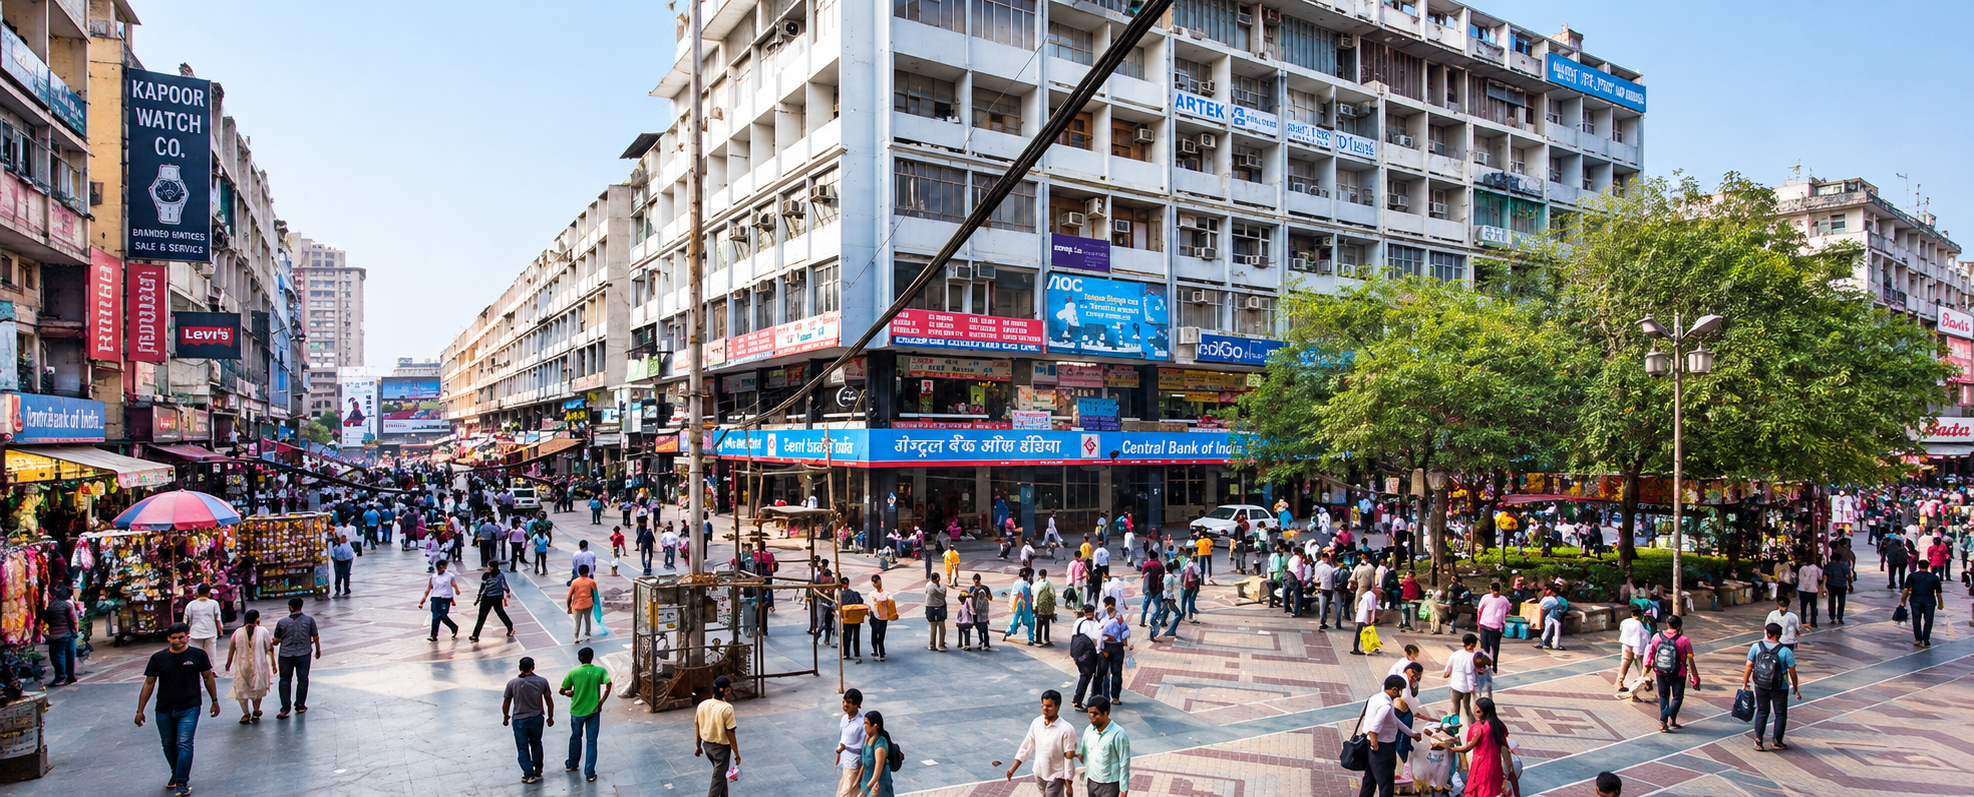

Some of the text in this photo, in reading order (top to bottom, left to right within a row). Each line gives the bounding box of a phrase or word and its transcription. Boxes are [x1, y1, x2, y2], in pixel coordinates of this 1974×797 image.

[132, 79, 205, 107] KAPOOR
[1175, 93, 1225, 120] ARTEK
[135, 107, 201, 134] WATCH
[154, 136, 185, 158] CO.
[135, 241, 156, 251] SALE
[185, 328, 229, 341] Levi's
[1122, 440, 1165, 454] Central
[1168, 441, 1198, 454] Bank
[1201, 440, 1214, 454] of
